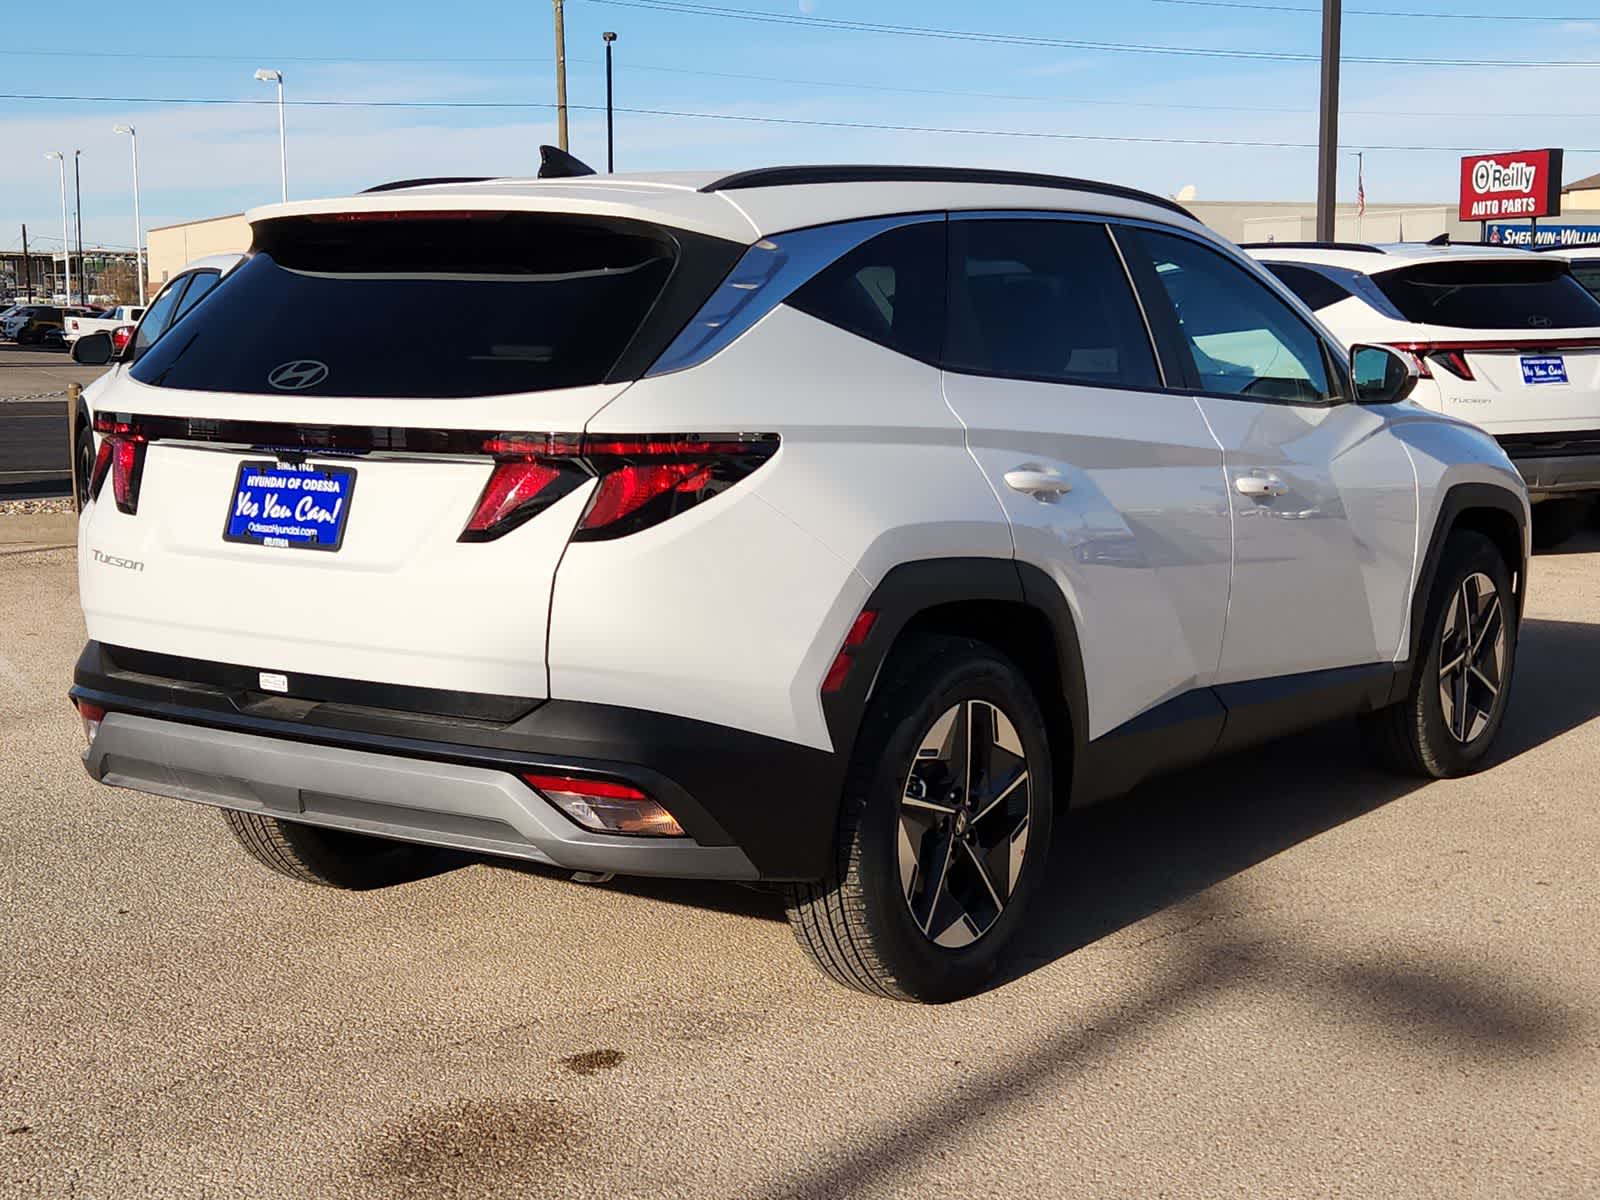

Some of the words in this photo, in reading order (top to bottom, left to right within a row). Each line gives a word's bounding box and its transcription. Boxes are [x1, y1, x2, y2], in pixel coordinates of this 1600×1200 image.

[1473, 160, 1536, 193] O'Reilly
[1471, 200, 1499, 216] AUTO
[1501, 197, 1536, 213] PARTS
[246, 475, 287, 489] HYUNDAI
[287, 477, 302, 490] OF
[302, 478, 340, 493] ODESSA
[235, 491, 259, 518] Yes
[262, 492, 292, 519] You
[294, 495, 342, 524] Can!
[91, 548, 145, 572] Tucson
